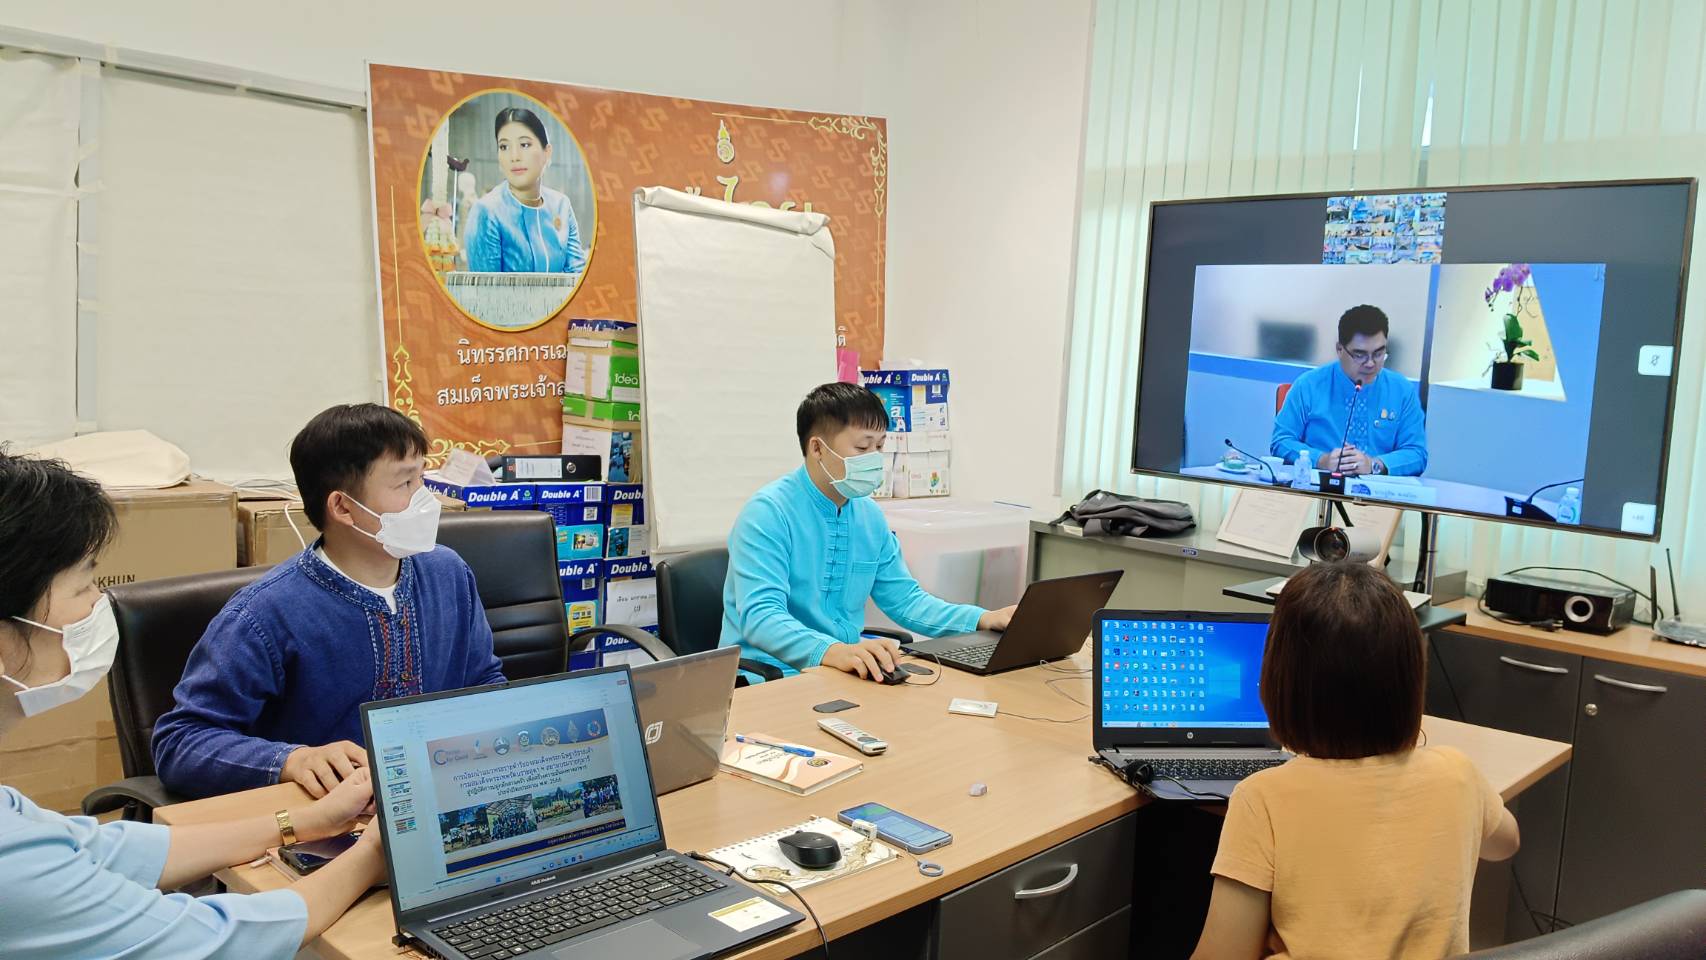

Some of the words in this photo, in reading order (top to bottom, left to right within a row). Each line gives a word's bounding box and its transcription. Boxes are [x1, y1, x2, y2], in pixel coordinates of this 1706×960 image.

[864, 374, 882, 384] uble
[912, 373, 933, 381] Double
[468, 491, 507, 502] Double
[510, 490, 519, 500] A
[541, 490, 571, 499] Double
[573, 490, 580, 498] A
[560, 564, 583, 576] uble
[586, 563, 595, 574] A
[610, 562, 647, 575] Double
[605, 637, 629, 647] Dou
